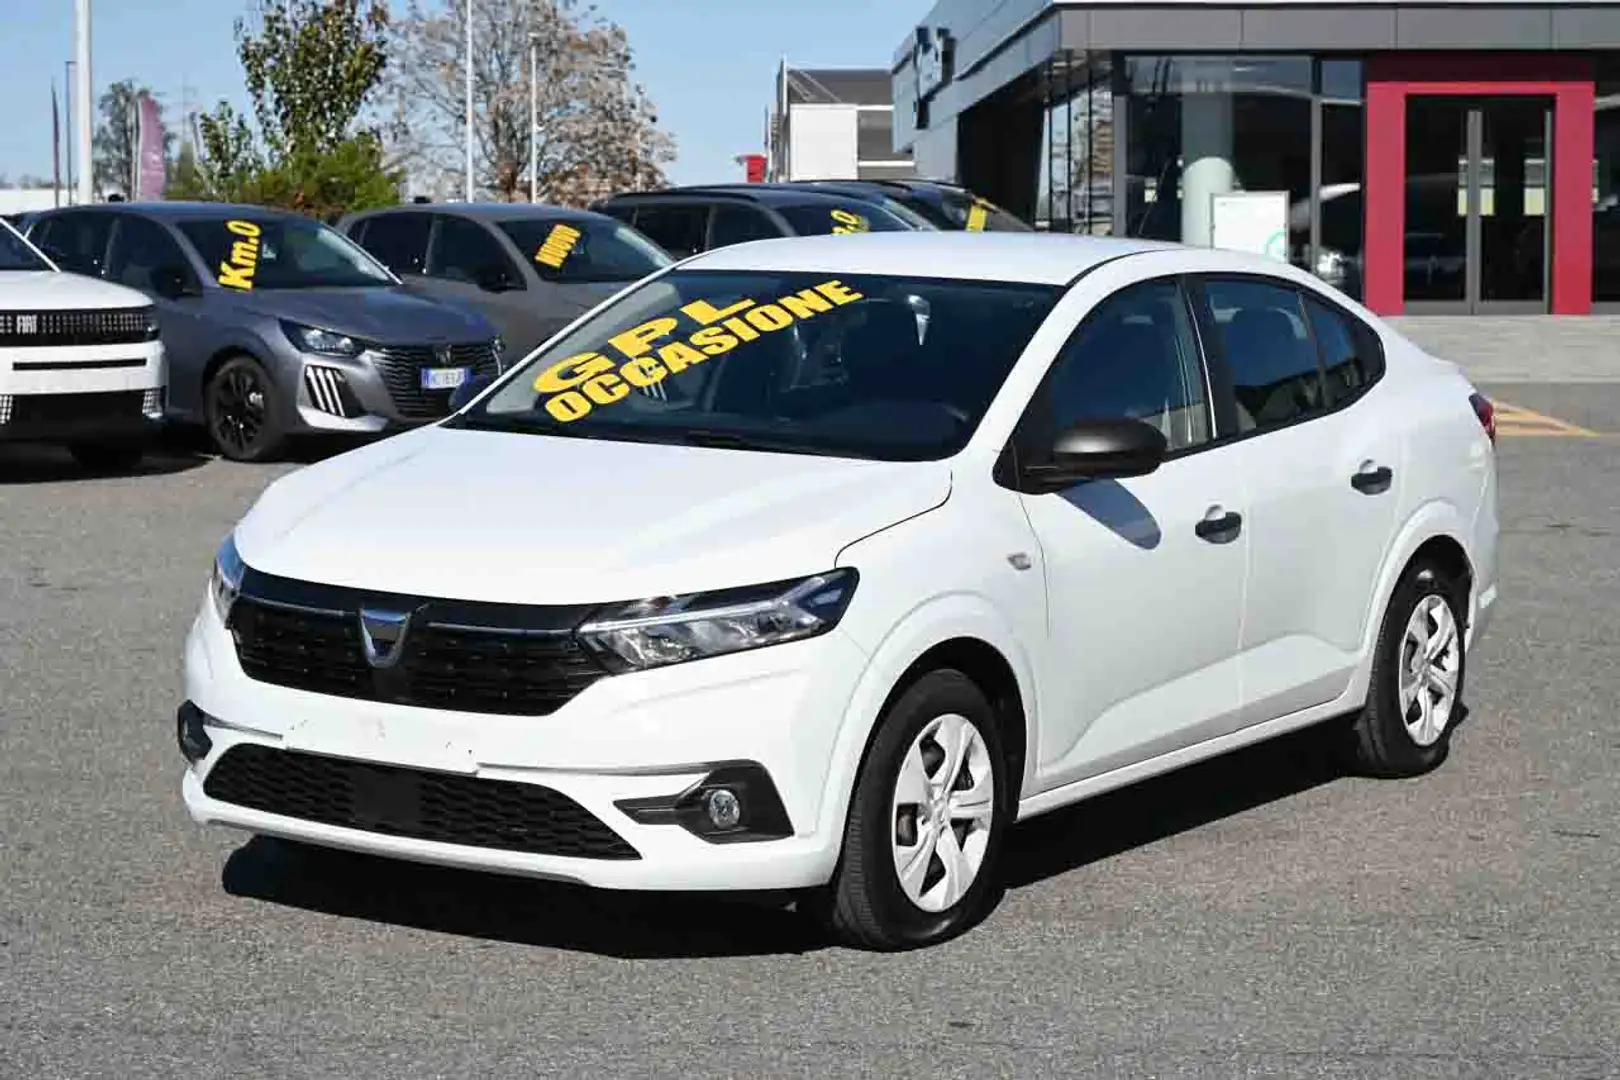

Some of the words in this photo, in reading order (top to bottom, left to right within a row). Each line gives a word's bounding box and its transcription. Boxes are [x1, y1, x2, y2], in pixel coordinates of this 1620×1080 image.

[218, 220, 261, 289] Km.0
[16, 315, 38, 335] FIAT
[533, 298, 756, 393] GPL
[545, 280, 862, 422] OCCASIONE
